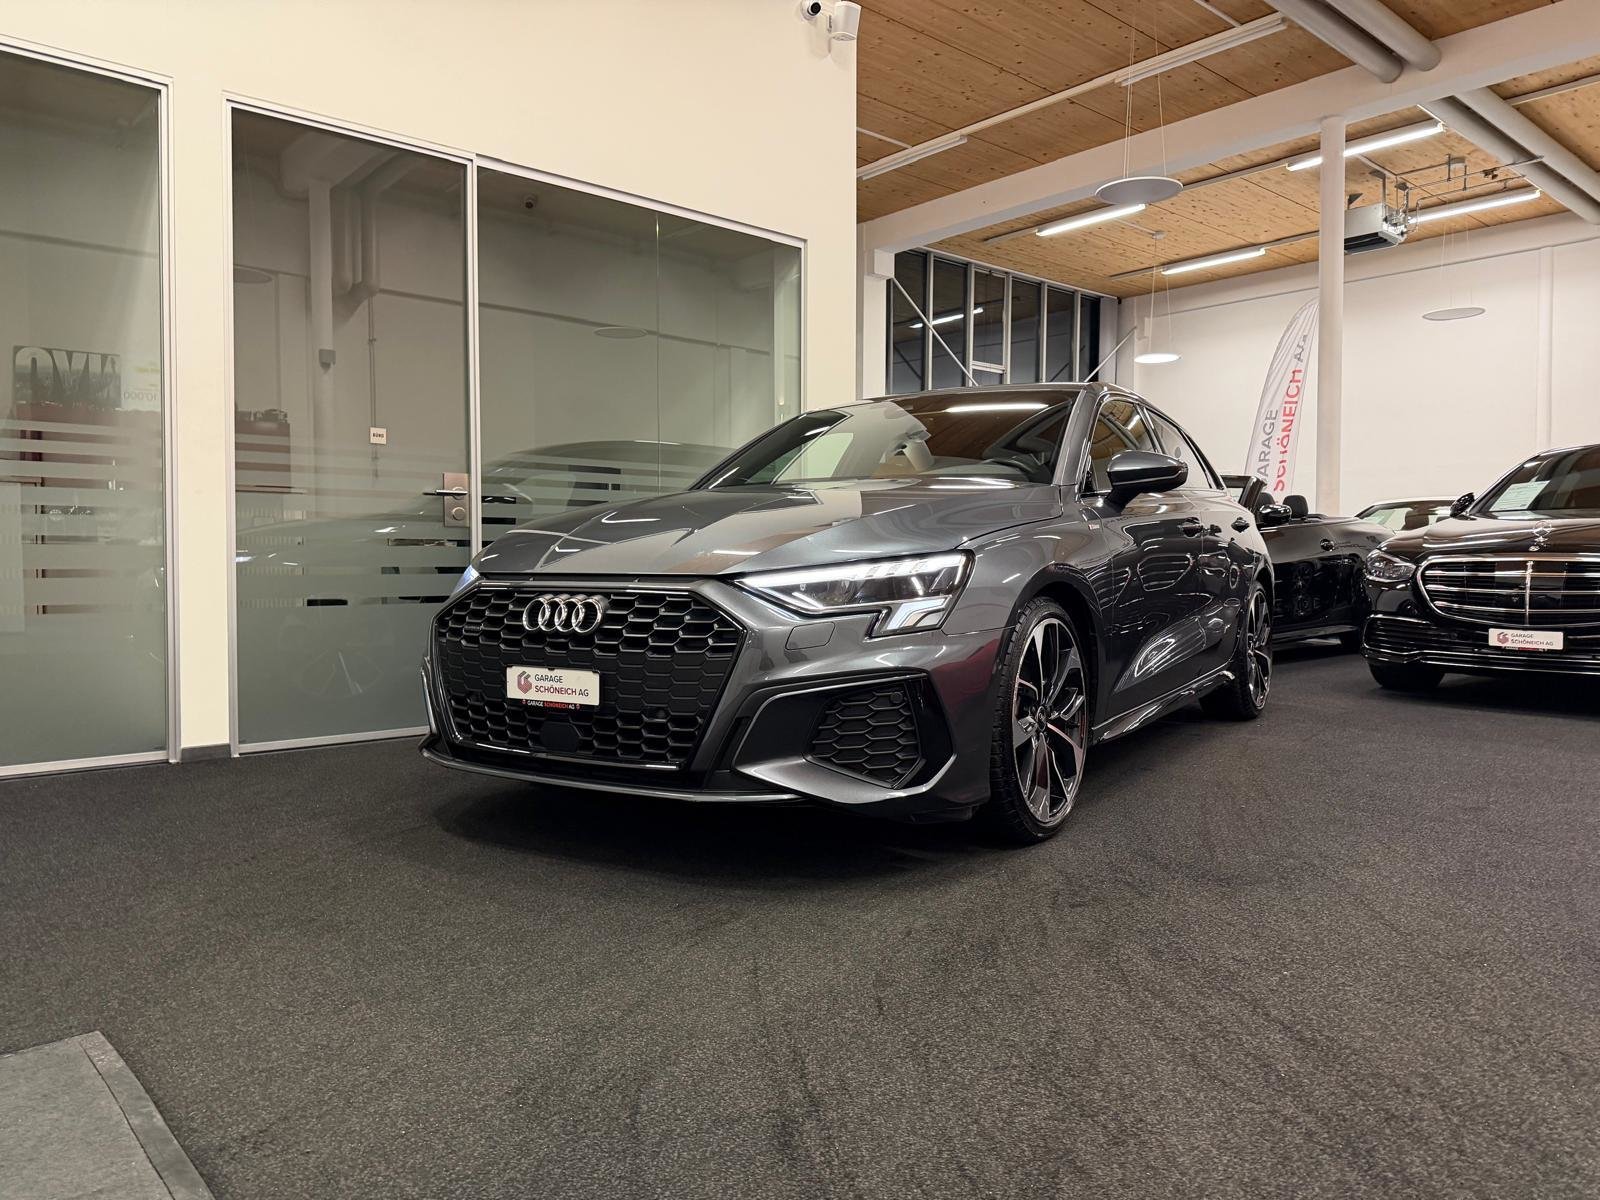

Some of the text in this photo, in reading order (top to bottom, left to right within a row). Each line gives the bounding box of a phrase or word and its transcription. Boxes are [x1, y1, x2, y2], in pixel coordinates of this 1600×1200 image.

[1257, 409, 1278, 481] ARAGE
[534, 674, 563, 683] GARAGE
[534, 685, 589, 697] SCHÖNEICH AG
